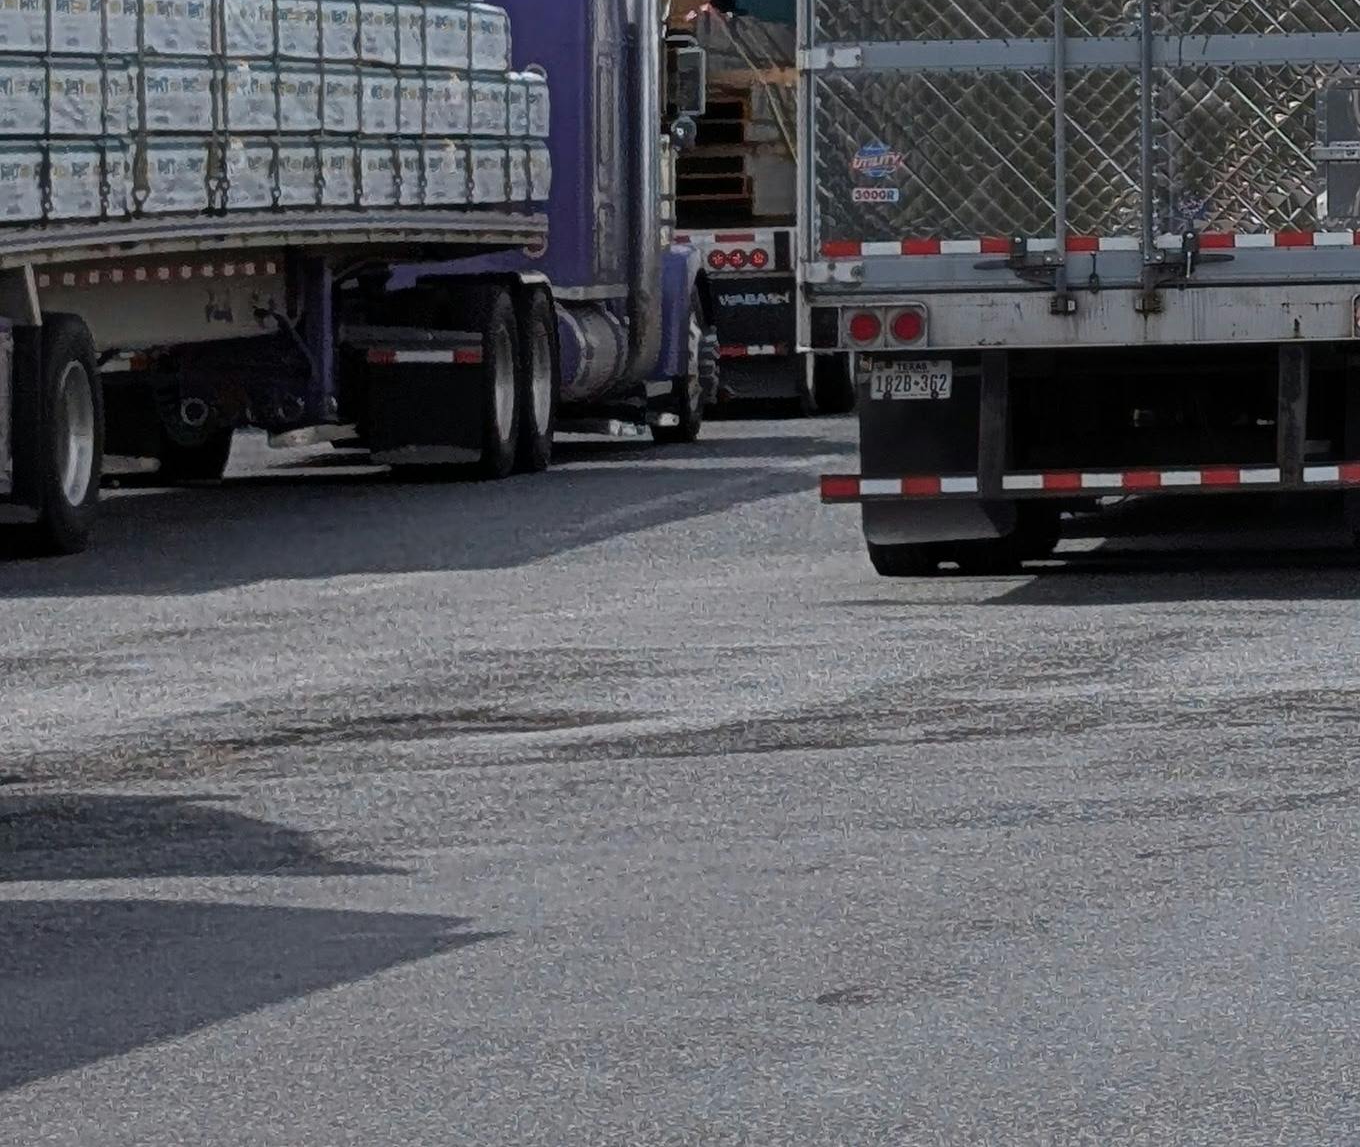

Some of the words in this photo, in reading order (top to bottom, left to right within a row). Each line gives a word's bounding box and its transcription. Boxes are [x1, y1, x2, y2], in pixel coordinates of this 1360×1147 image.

[852, 152, 900, 170] UTILITY
[855, 189, 895, 201] 3000R
[896, 363, 929, 371] TEXAS
